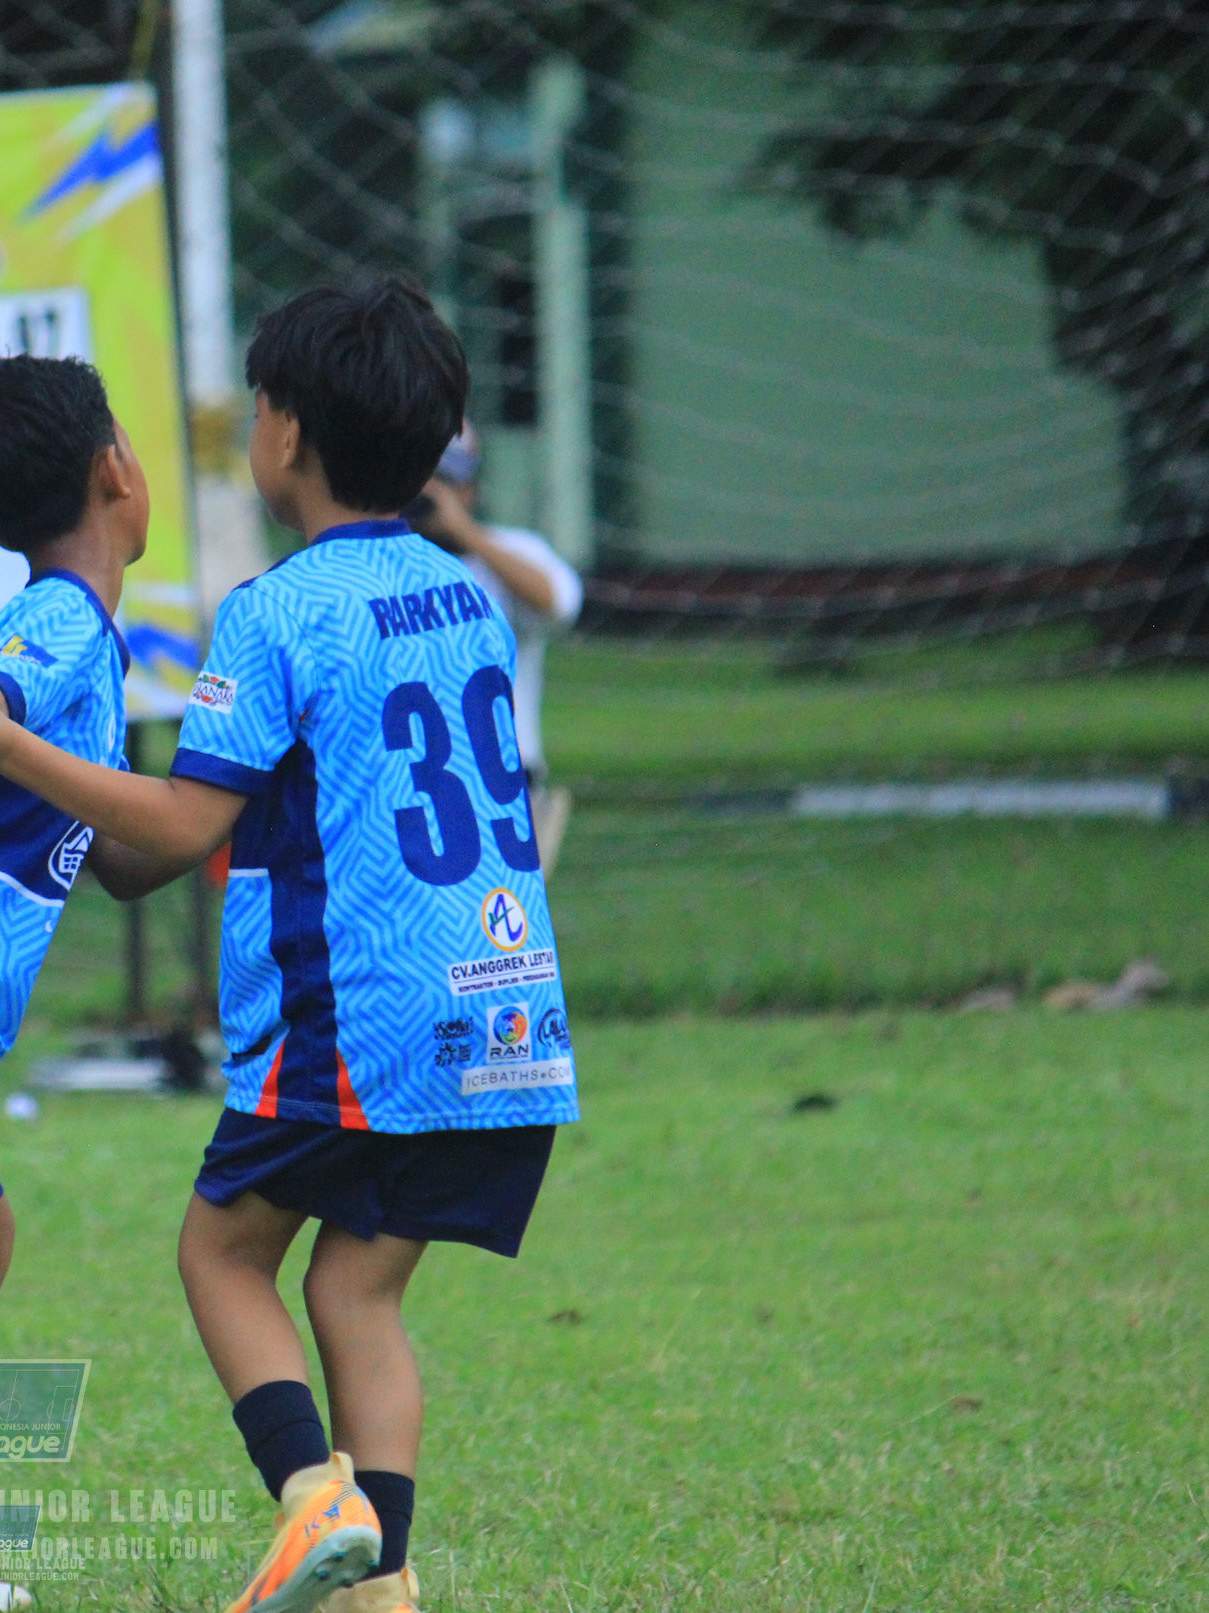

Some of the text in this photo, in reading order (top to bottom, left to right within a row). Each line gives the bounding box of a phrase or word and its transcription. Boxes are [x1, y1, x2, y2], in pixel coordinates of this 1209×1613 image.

[382, 664, 541, 886] 39
[451, 955, 527, 980] CV.ANGGREK
[490, 1043, 530, 1058] RAN
